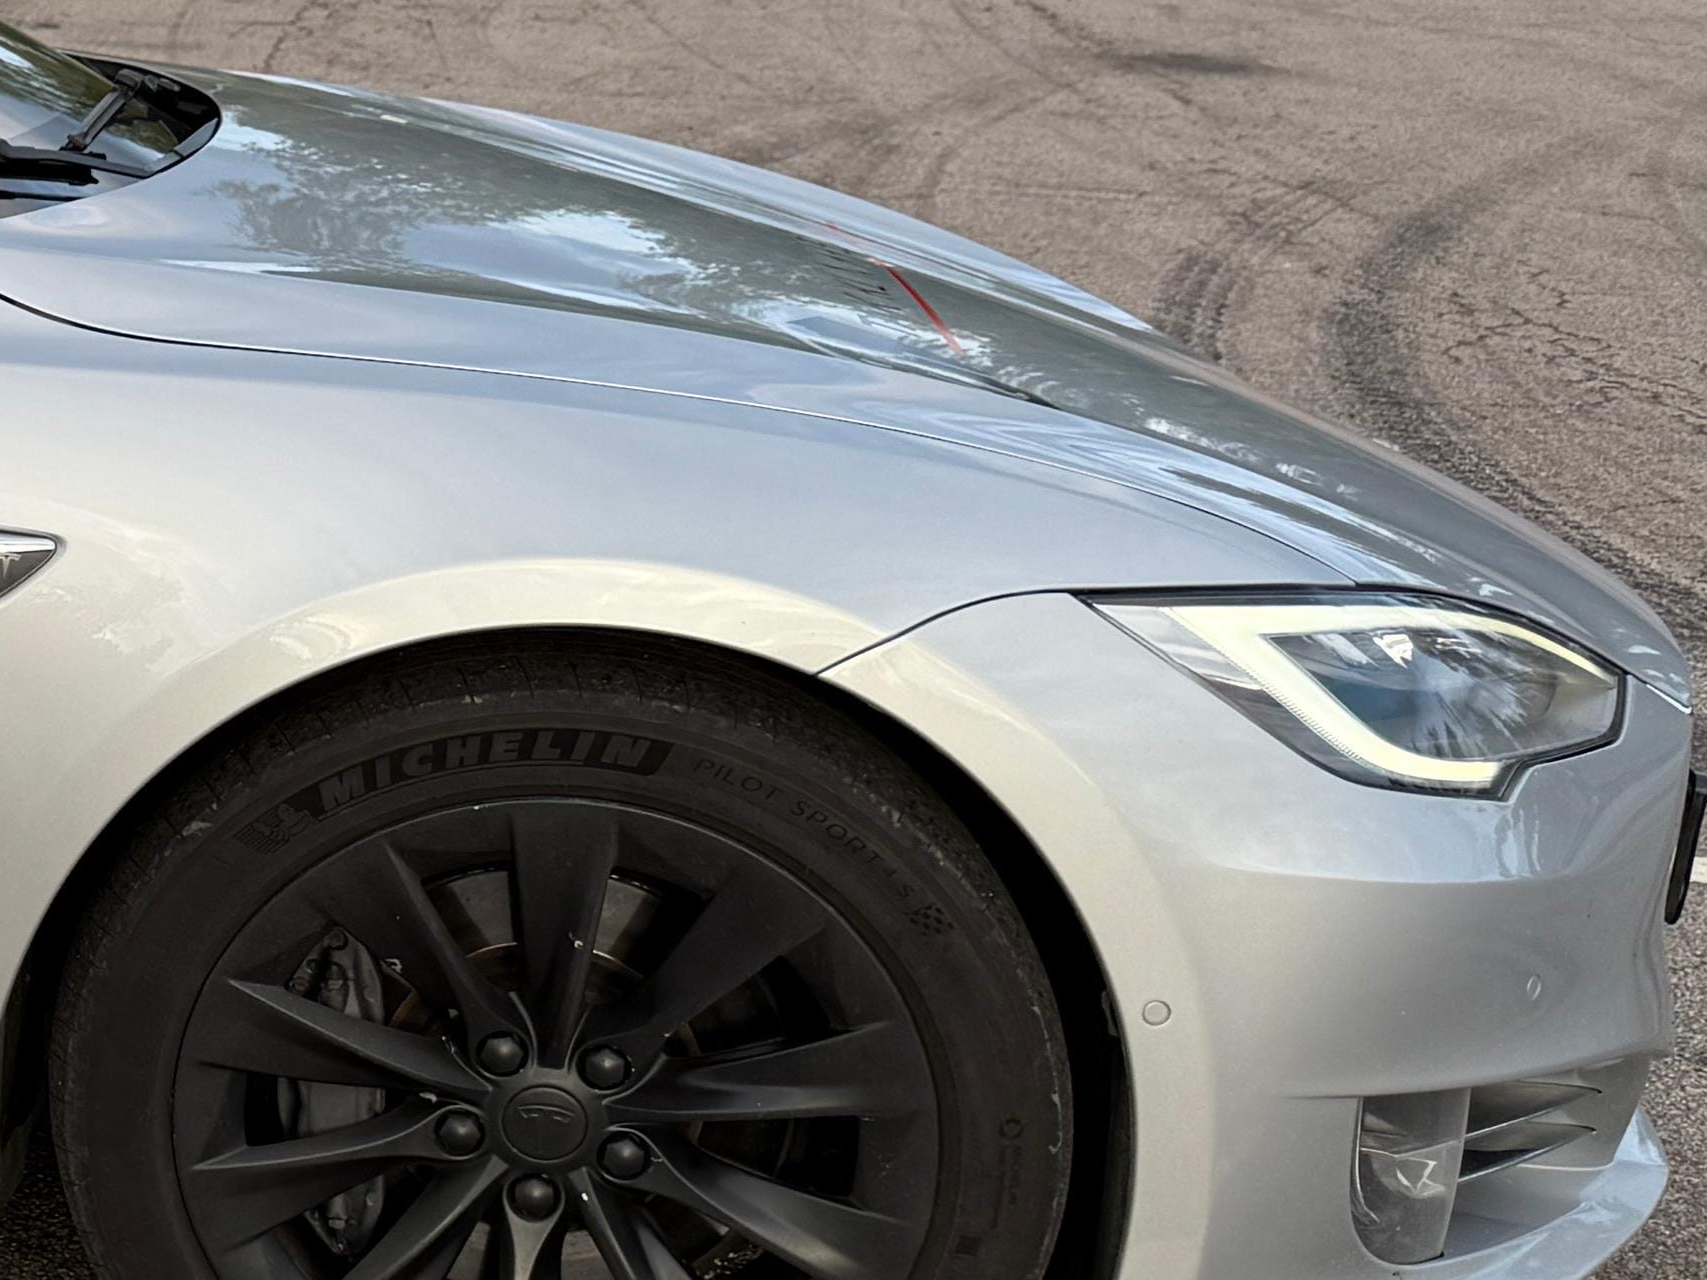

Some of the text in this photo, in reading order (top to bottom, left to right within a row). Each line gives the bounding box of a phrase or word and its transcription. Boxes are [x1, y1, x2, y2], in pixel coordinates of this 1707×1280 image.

[322, 729, 653, 810] MICHELIN
[692, 755, 783, 801] PILOT
[789, 797, 884, 869] SPORT
